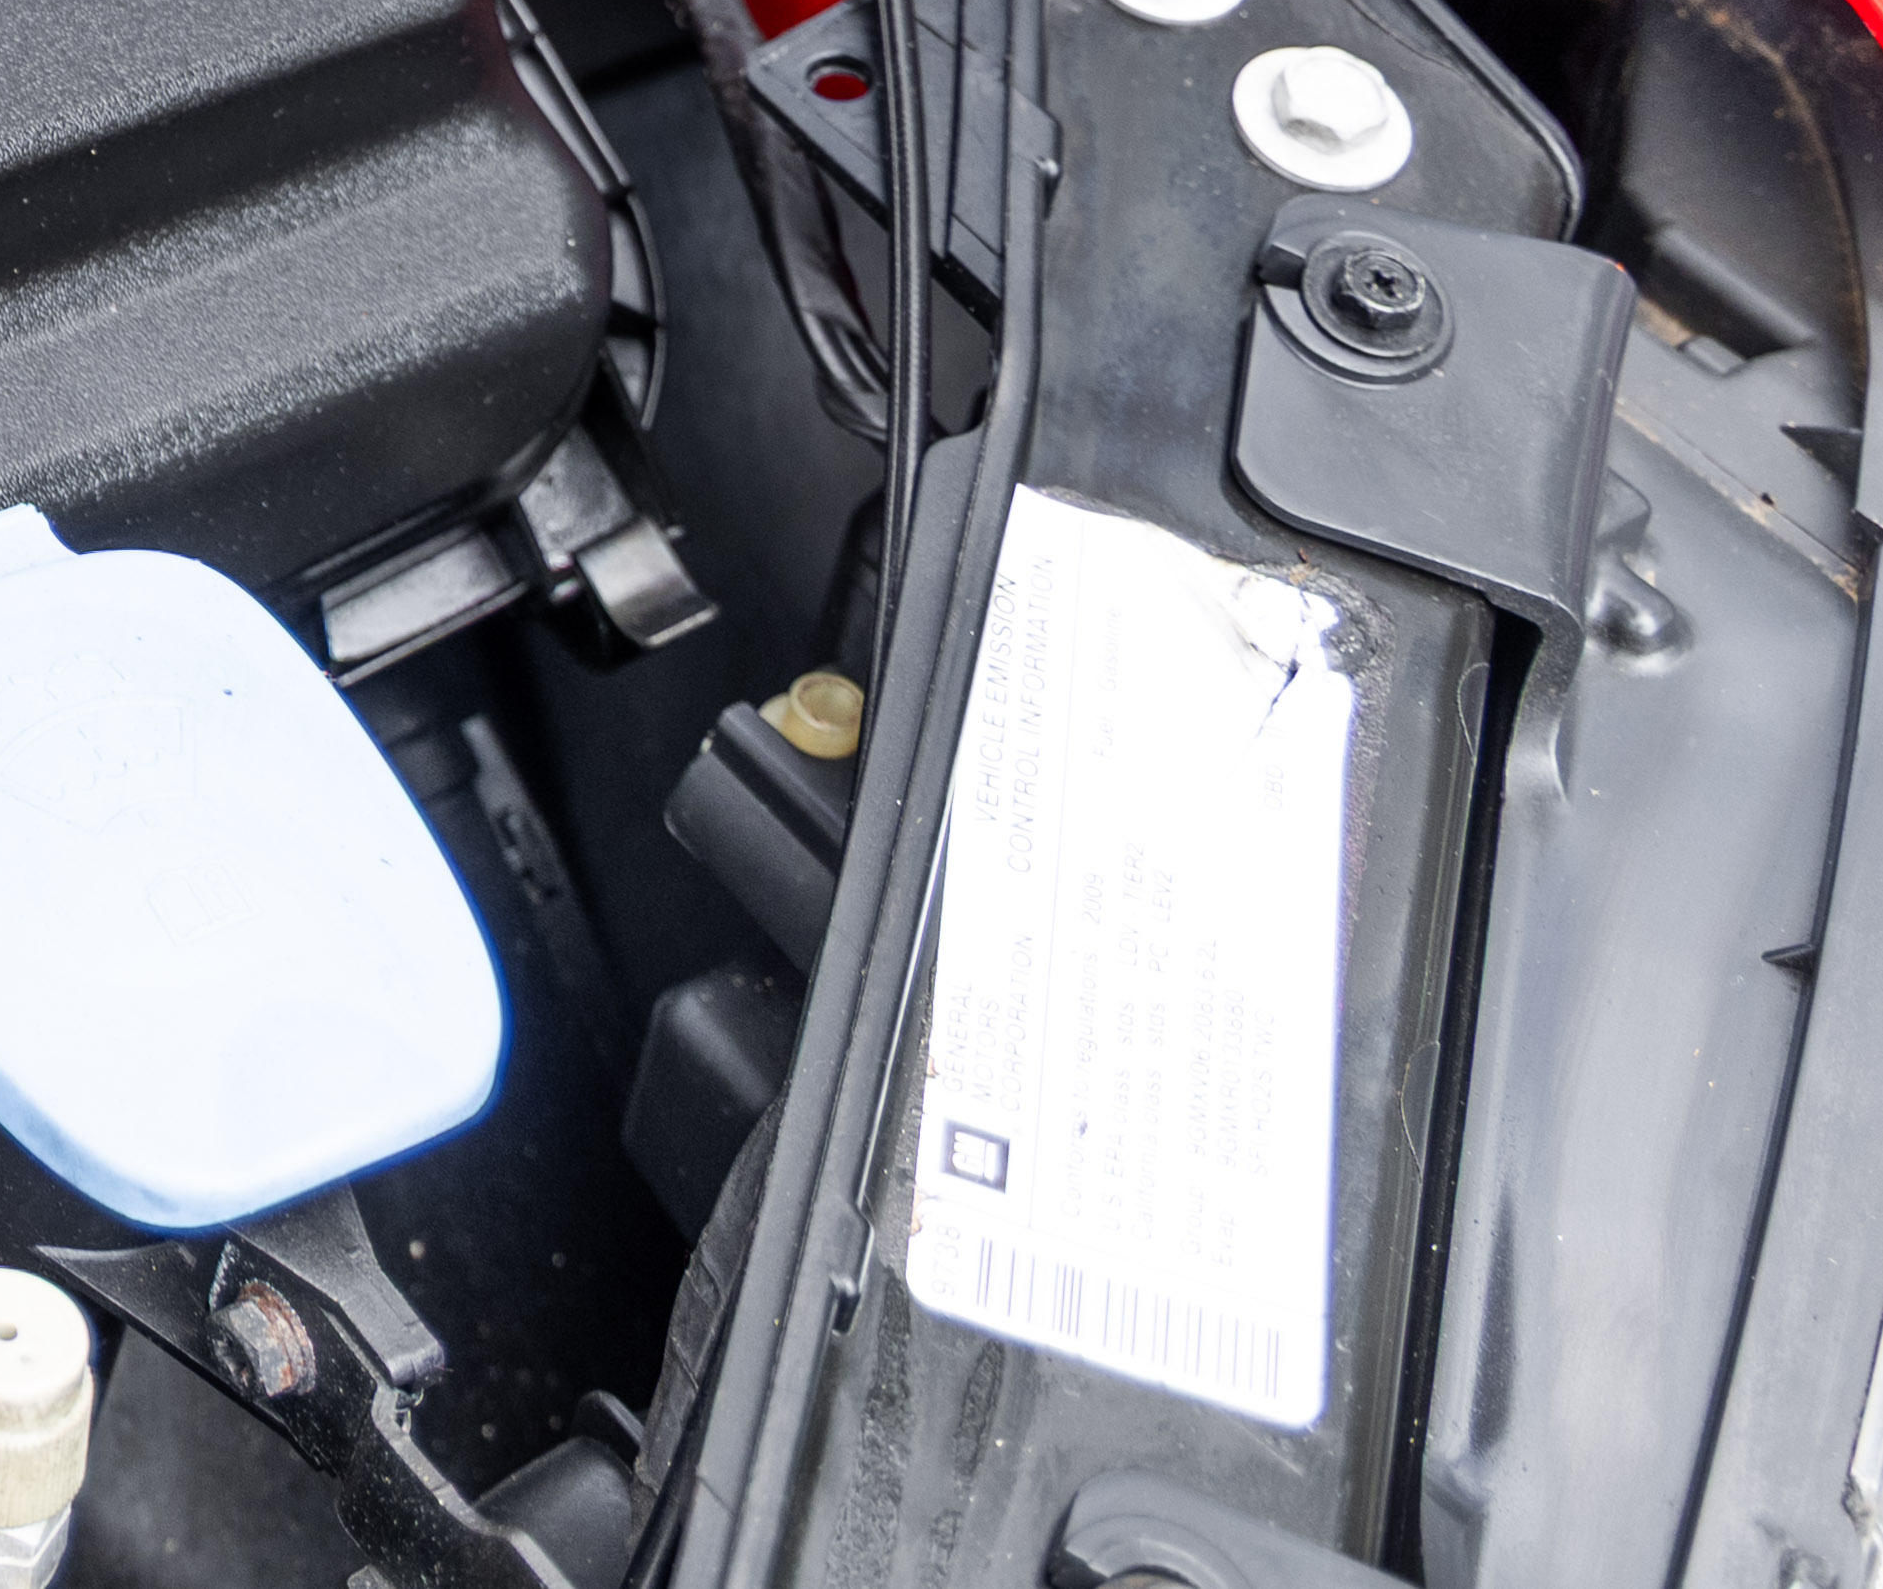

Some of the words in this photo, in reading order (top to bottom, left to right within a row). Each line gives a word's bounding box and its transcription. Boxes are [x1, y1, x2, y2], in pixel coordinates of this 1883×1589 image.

[986, 572, 1017, 706] EMISSION
[1017, 554, 1054, 736] INFORMATION
[974, 712, 1007, 822] VEHICLE
[1003, 745, 1042, 874] CONTROL
[1078, 870, 1105, 927] 2009
[941, 981, 974, 1093] GENERAL
[969, 995, 1001, 1103] MOTORS
[998, 931, 1035, 1112] CORPORATION
[1102, 1132, 1126, 1178] EPA
[1129, 1130, 1159, 1242] California
[932, 1224, 962, 1296] 9738
